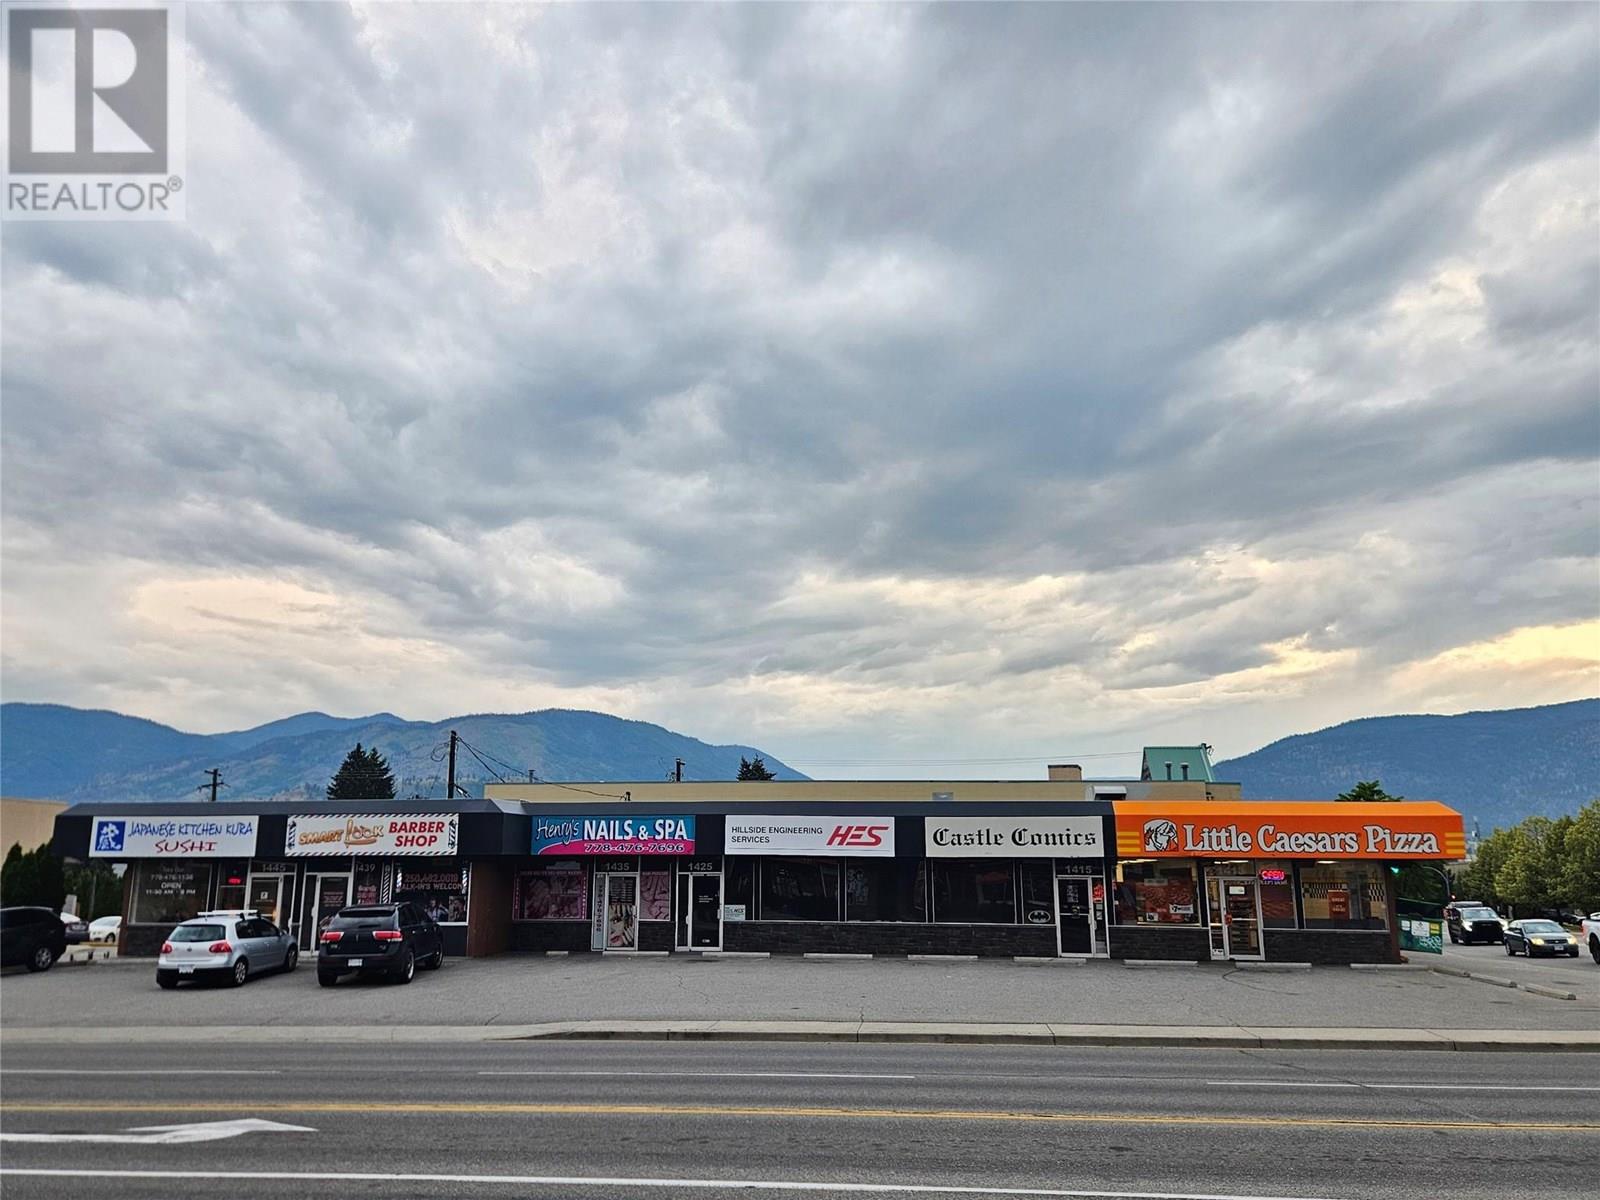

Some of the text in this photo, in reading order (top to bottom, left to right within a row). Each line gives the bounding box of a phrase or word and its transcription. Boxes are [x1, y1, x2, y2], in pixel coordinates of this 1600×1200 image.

[128, 820, 253, 838] JAPANESE KITCHEN KURA
[389, 821, 445, 834] BARBER
[535, 818, 688, 845] Henry's NAILS & SPA
[731, 826, 823, 835] HILLSIDE ENGINEERING
[298, 830, 344, 846] SMART
[395, 835, 438, 847] SHOP
[731, 835, 770, 844] SERVICES
[826, 825, 890, 847] HES
[933, 827, 1097, 847] Castle Comics
[1184, 823, 1440, 854] Little Caesars Pizza
[154, 839, 218, 854] SUSHI
[584, 842, 684, 853] 778-476-7696
[262, 864, 286, 872] 1445
[605, 862, 630, 871] 1435
[688, 862, 713, 871] 1425
[1065, 866, 1092, 874] 1415
[1261, 870, 1285, 880] OPEN
[160, 881, 182, 889] OPEN
[401, 882, 430, 890] ALK-IN'S
